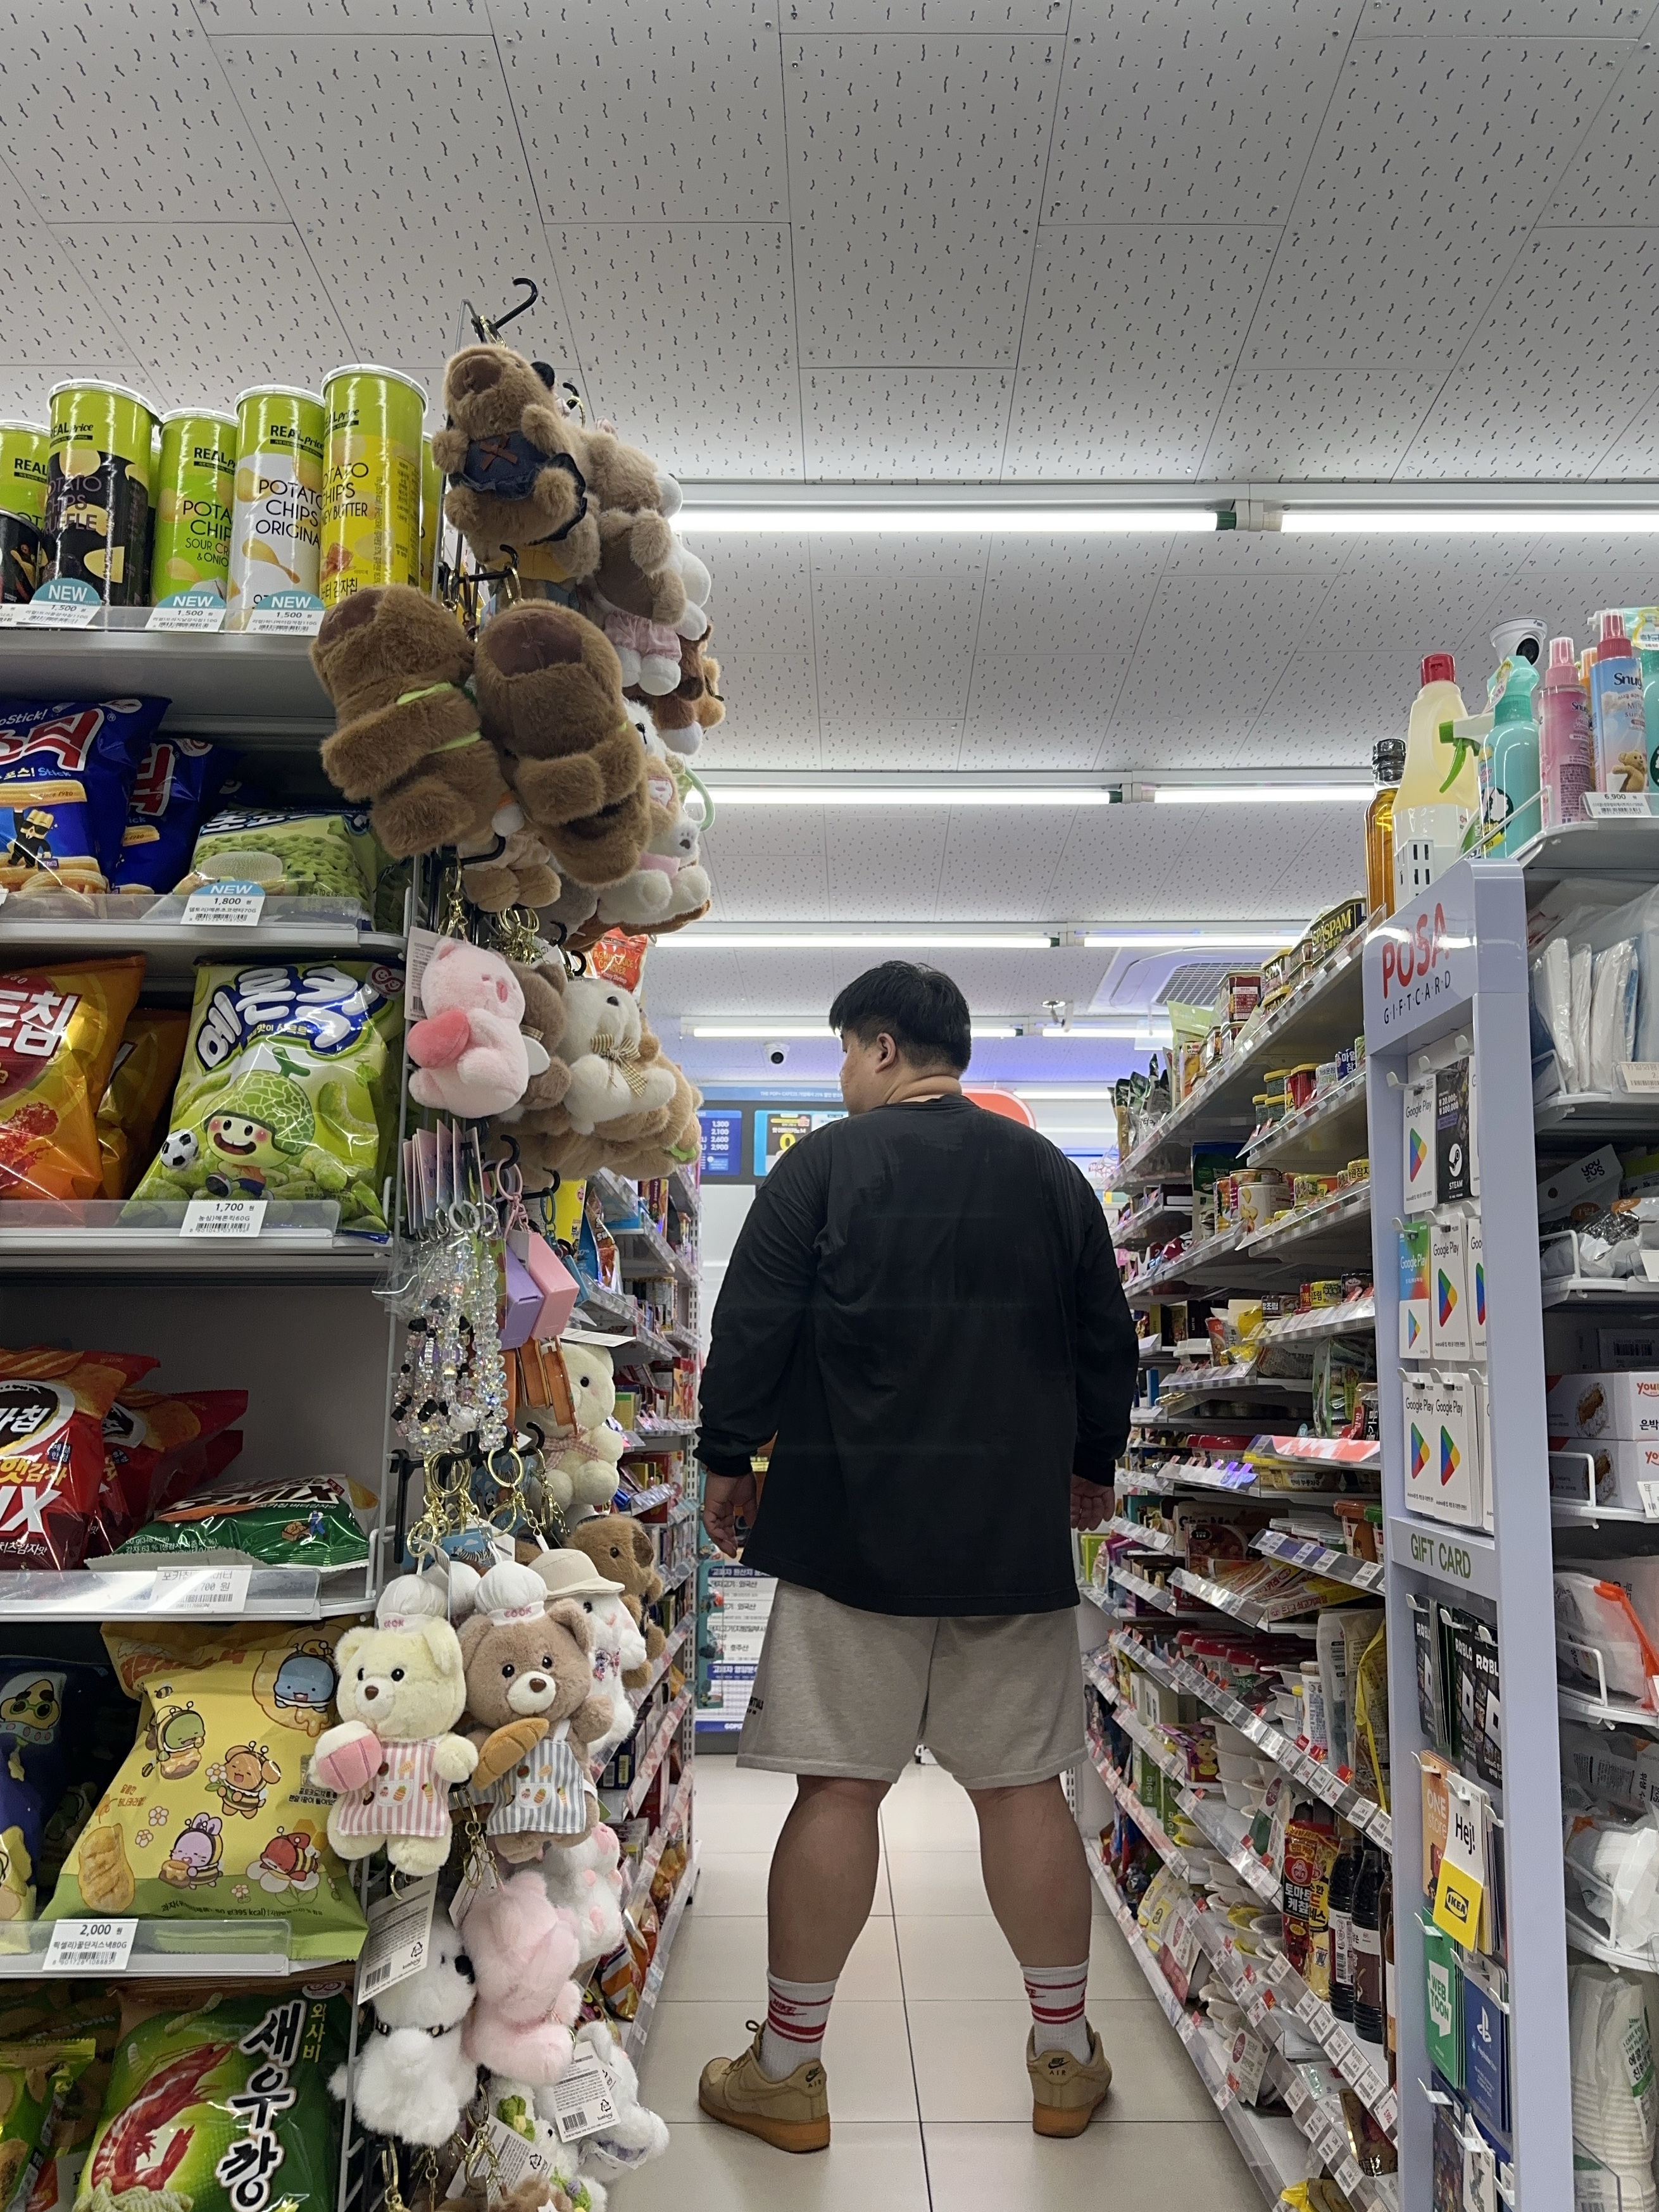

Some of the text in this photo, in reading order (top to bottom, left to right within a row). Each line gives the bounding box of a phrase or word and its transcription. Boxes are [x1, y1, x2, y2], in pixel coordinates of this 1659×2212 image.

[339, 409, 360, 421] Price
[270, 425, 304, 442] REAL
[194, 447, 224, 464] REAL
[322, 463, 369, 485] OTATO
[47, 476, 102, 498] OTATO
[183, 501, 232, 522] POTA
[266, 500, 318, 527] CHIPS
[333, 503, 368, 517] BUTTER
[191, 520, 232, 542] CHIP
[256, 520, 321, 550] ORIGINA
[185, 537, 213, 552] SOUR
[203, 554, 229, 568] ONIO
[48, 585, 88, 602] NEW
[333, 577, 358, 597] 감자칩
[51, 604, 77, 613] 1,500
[172, 596, 214, 608] NEW
[271, 597, 311, 608] NEW
[1614, 673, 1643, 690] Snug
[38, 767, 72, 777] Stick
[210, 885, 253, 894] NEW
[1323, 909, 1352, 942] SPAM
[1382, 902, 1451, 999] POSA
[3, 973, 28, 984] 980
[1342, 1051, 1356, 1062] 마일
[1406, 1100, 1432, 1120] Google Play
[1449, 1179, 1463, 1190] STEAM
[216, 1203, 244, 1211] 1,700
[1434, 1240, 1459, 1258] Google Play
[1470, 1237, 1482, 1250] Goo
[1400, 1253, 1427, 1272] Google Play
[1406, 1397, 1434, 1415] Google Play
[1436, 1399, 1463, 1417] Google Play
[1410, 1532, 1471, 1579] GIFT CARD
[220, 1583, 230, 1592] 원
[504, 1606, 532, 1617] COOK
[1455, 1637, 1474, 1661] ROBLO
[1476, 1653, 1499, 1677] ROBL
[315, 1797, 335, 1806] 들어있
[1426, 1789, 1448, 1819] ONE
[1426, 1814, 1448, 1839] store
[1455, 1813, 1476, 1855] Hej!
[1285, 1882, 1310, 1898] 토마토
[1446, 1889, 1468, 1915] IKEA
[249, 1908, 266, 1916] kcal)
[80, 1924, 111, 1937] 2,000
[1430, 1973, 1448, 2001] WEB
[772, 1998, 797, 2014] NIKE
[1430, 1991, 1451, 2023] TOON
[808, 2078, 822, 2089] AIR
[215, 1999, 307, 2212] 새우깡
